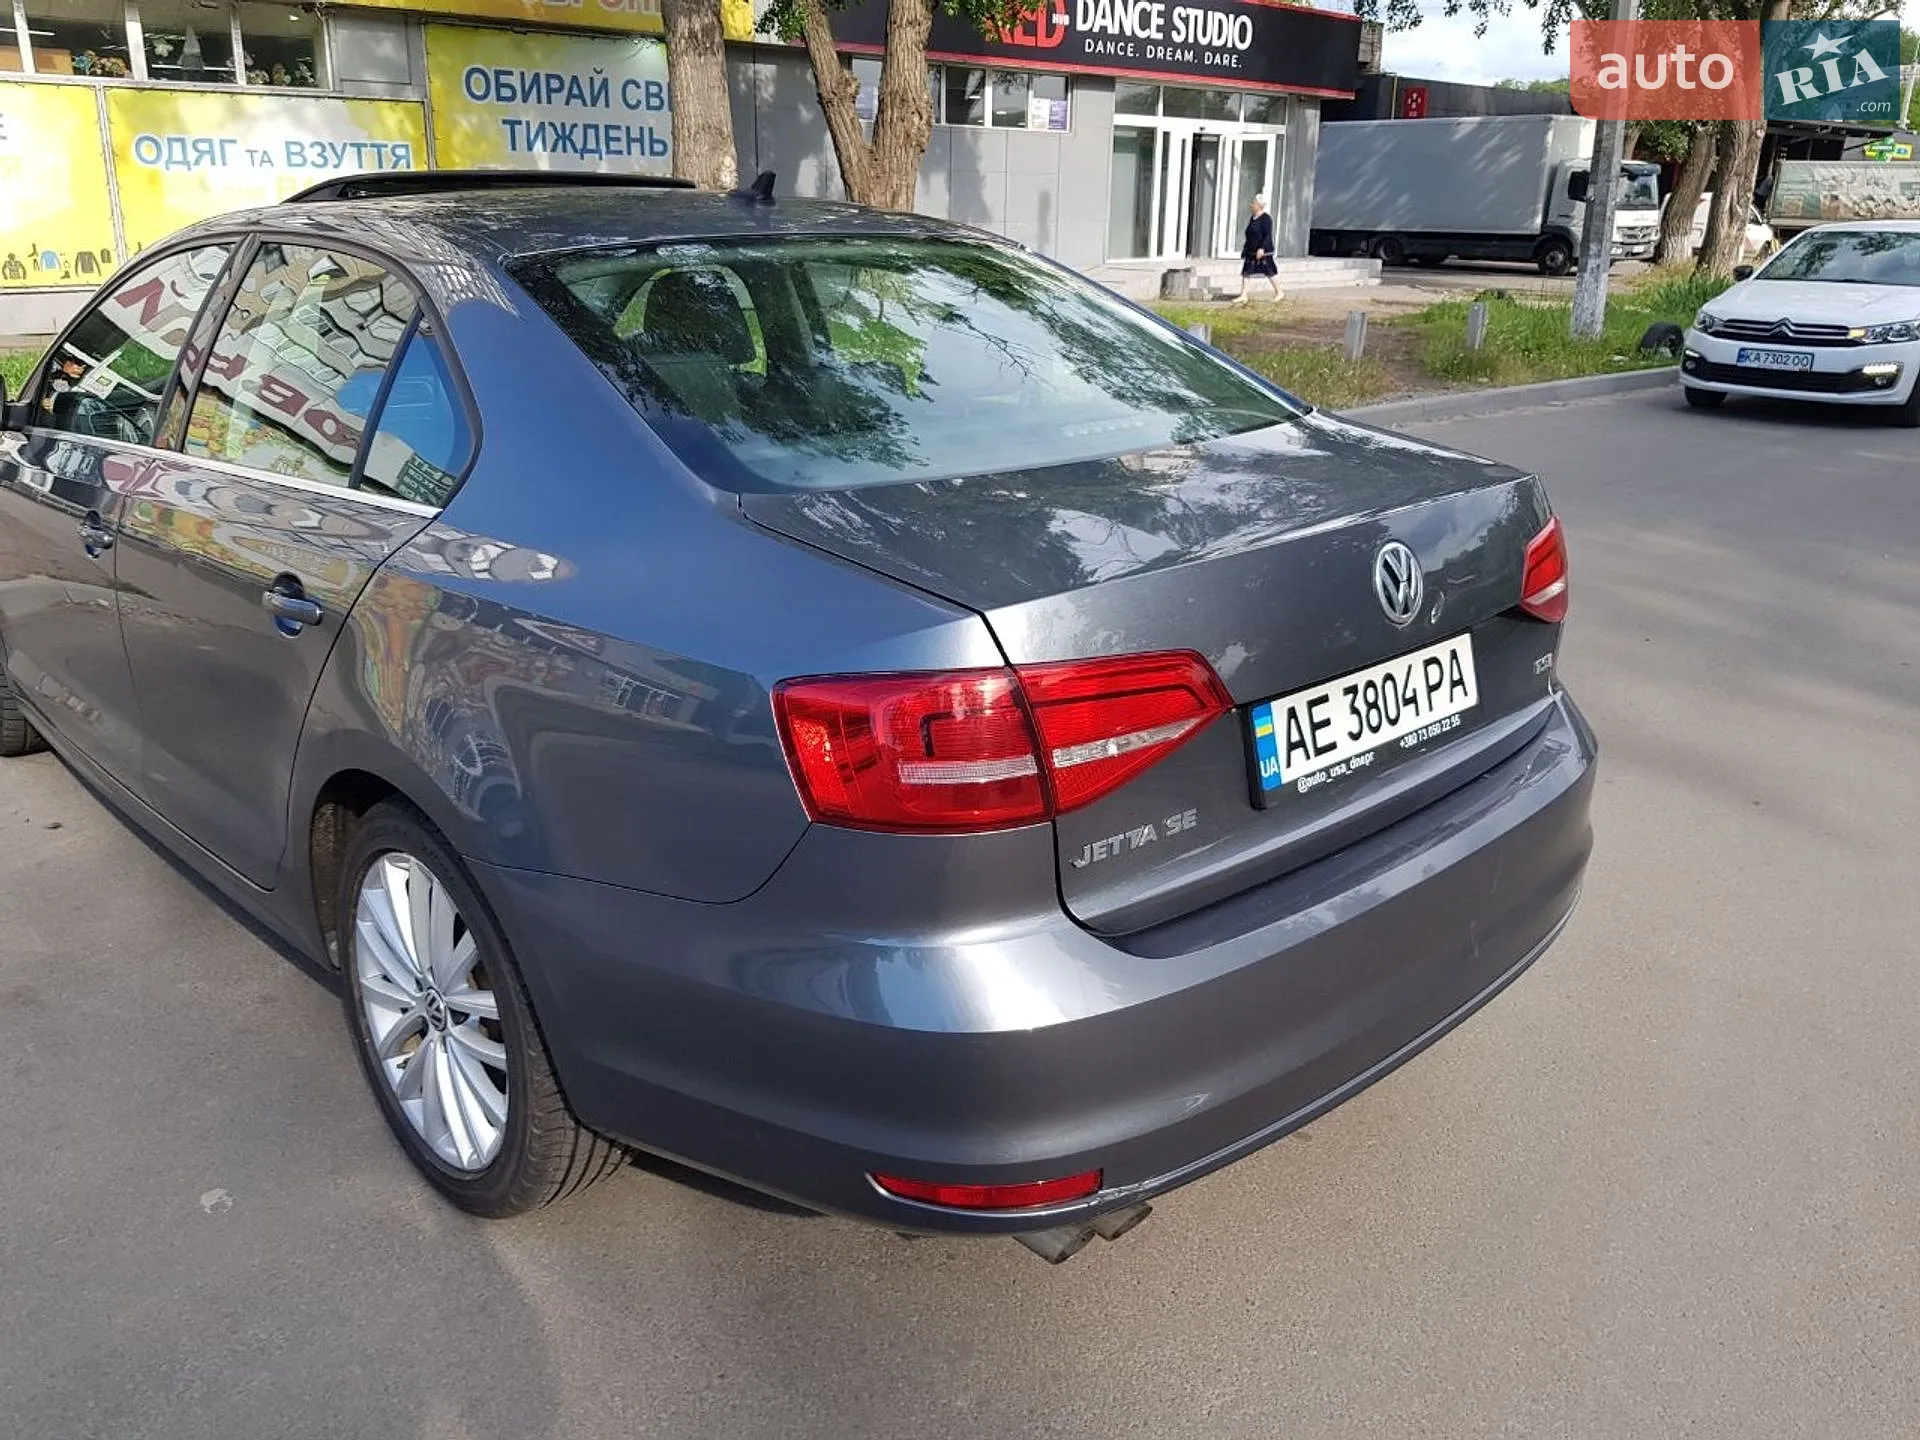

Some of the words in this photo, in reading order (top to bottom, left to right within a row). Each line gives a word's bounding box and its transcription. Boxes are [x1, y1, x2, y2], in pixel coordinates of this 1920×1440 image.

[1076, 0, 1165, 41] DANCE
[1171, 5, 1253, 51] STUDIO
[1084, 38, 1140, 58] DANCE.
[1146, 44, 1198, 64] DREAM.
[1204, 51, 1242, 69] DARE.
[464, 67, 610, 108] ОБИРАЙ
[621, 78, 672, 111] СВ
[135, 134, 238, 171] ОДЯГ
[285, 140, 411, 169] ВЗУТТЯ
[502, 118, 668, 160] ТИЖДЕНЬ
[1260, 756, 1279, 778] UA
[1068, 823, 1158, 868] JETTA
[1163, 808, 1198, 836] SE
